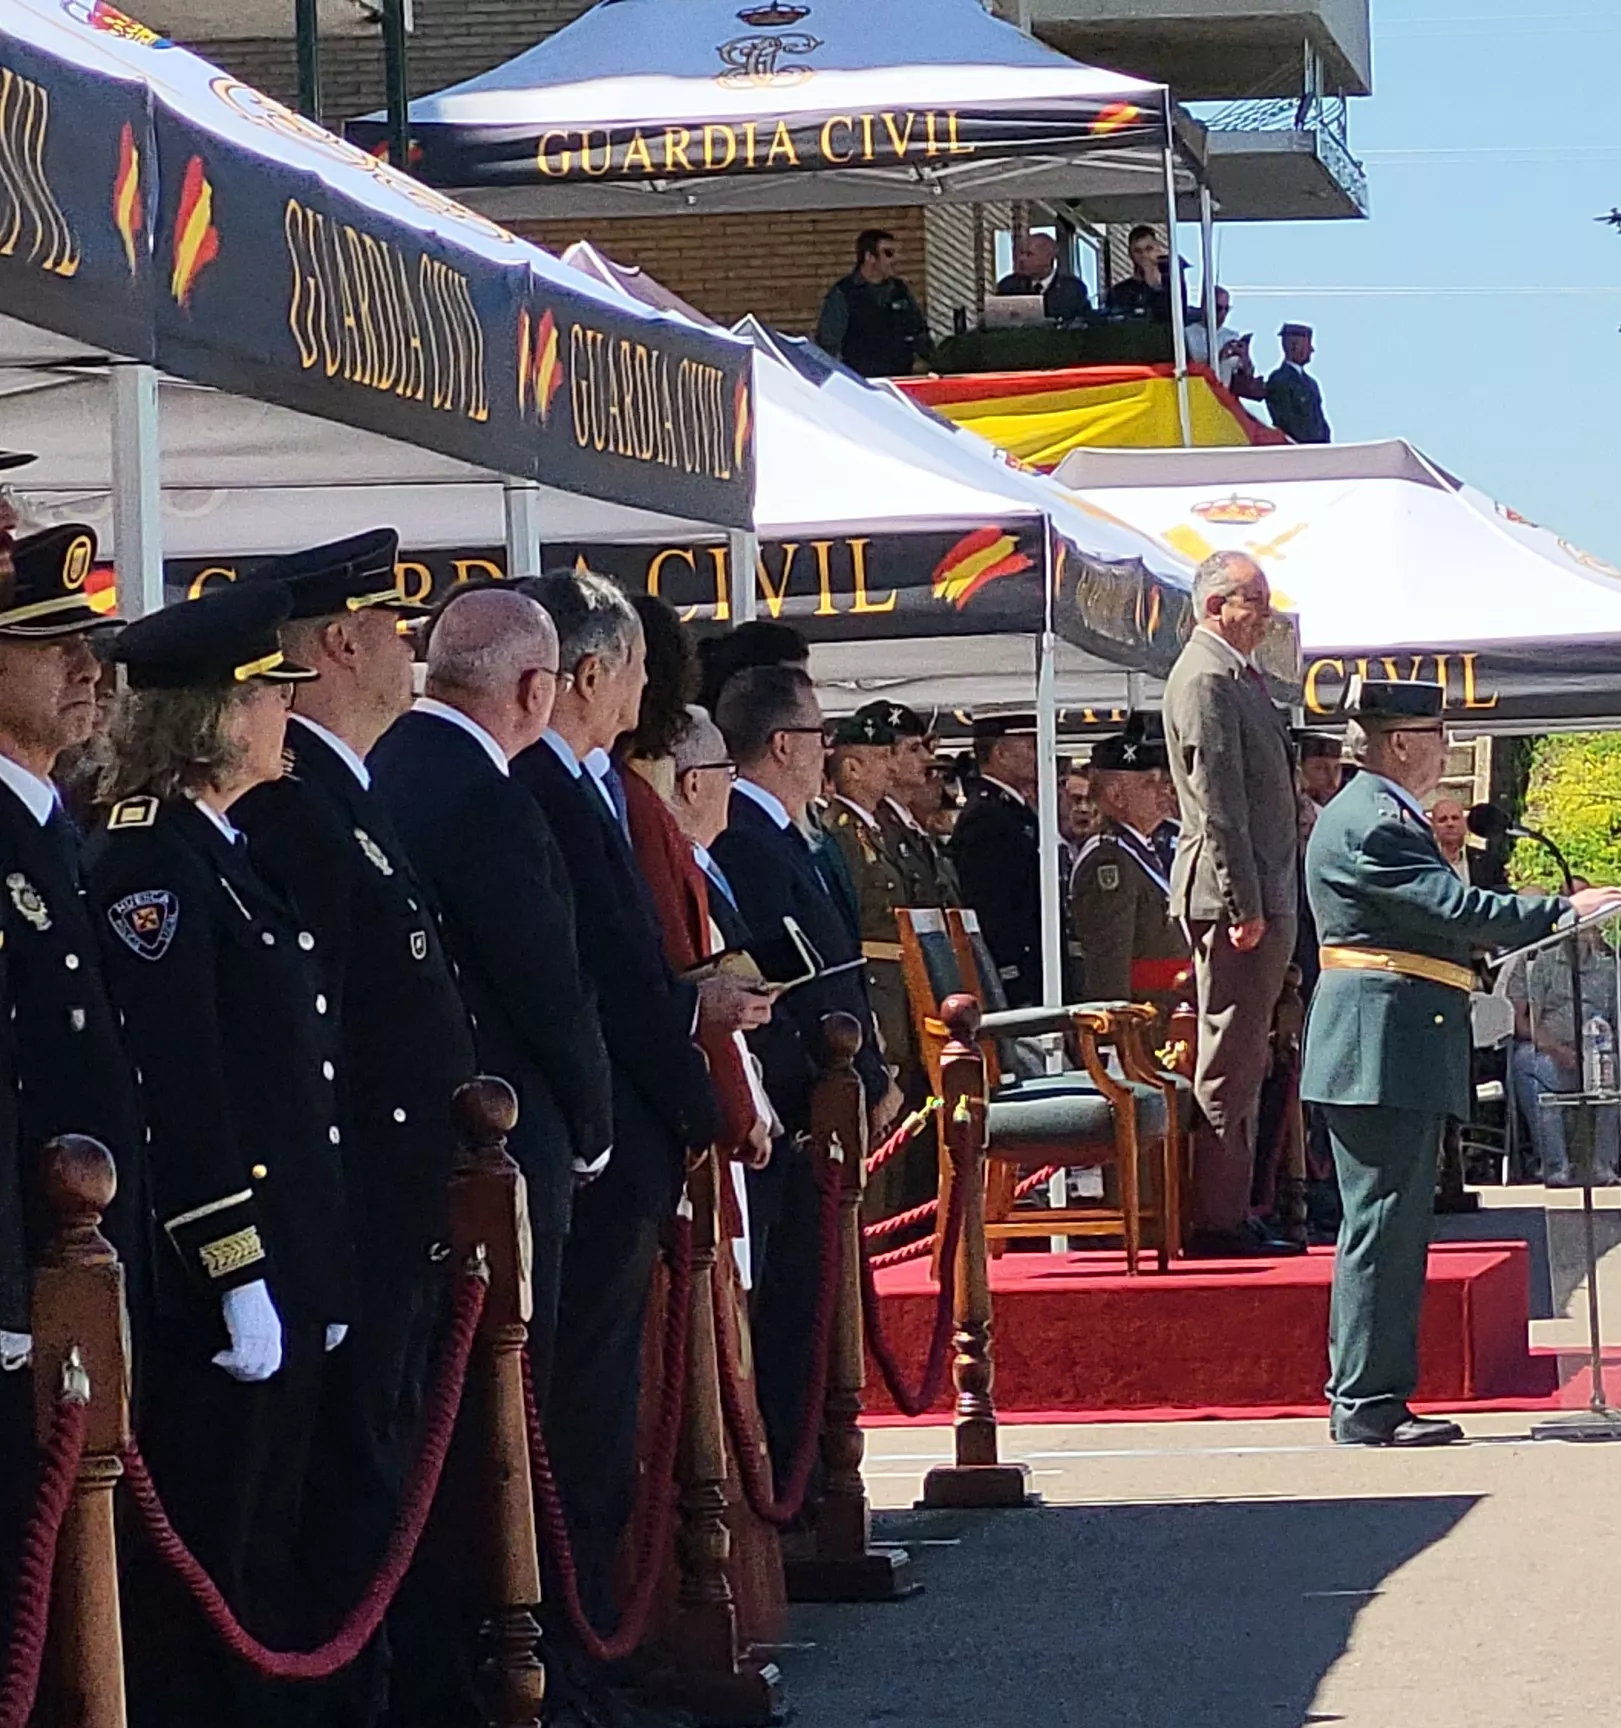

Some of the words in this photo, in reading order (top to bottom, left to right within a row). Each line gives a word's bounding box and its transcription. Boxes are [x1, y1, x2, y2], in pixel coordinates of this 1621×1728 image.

[537, 120, 800, 177] GUARDIA
[820, 109, 976, 164] CIVIL
[285, 198, 425, 401] GUARDIA
[419, 253, 489, 423] CIVIL
[571, 324, 678, 468] GUARDIA
[678, 357, 731, 480] CIVIL
